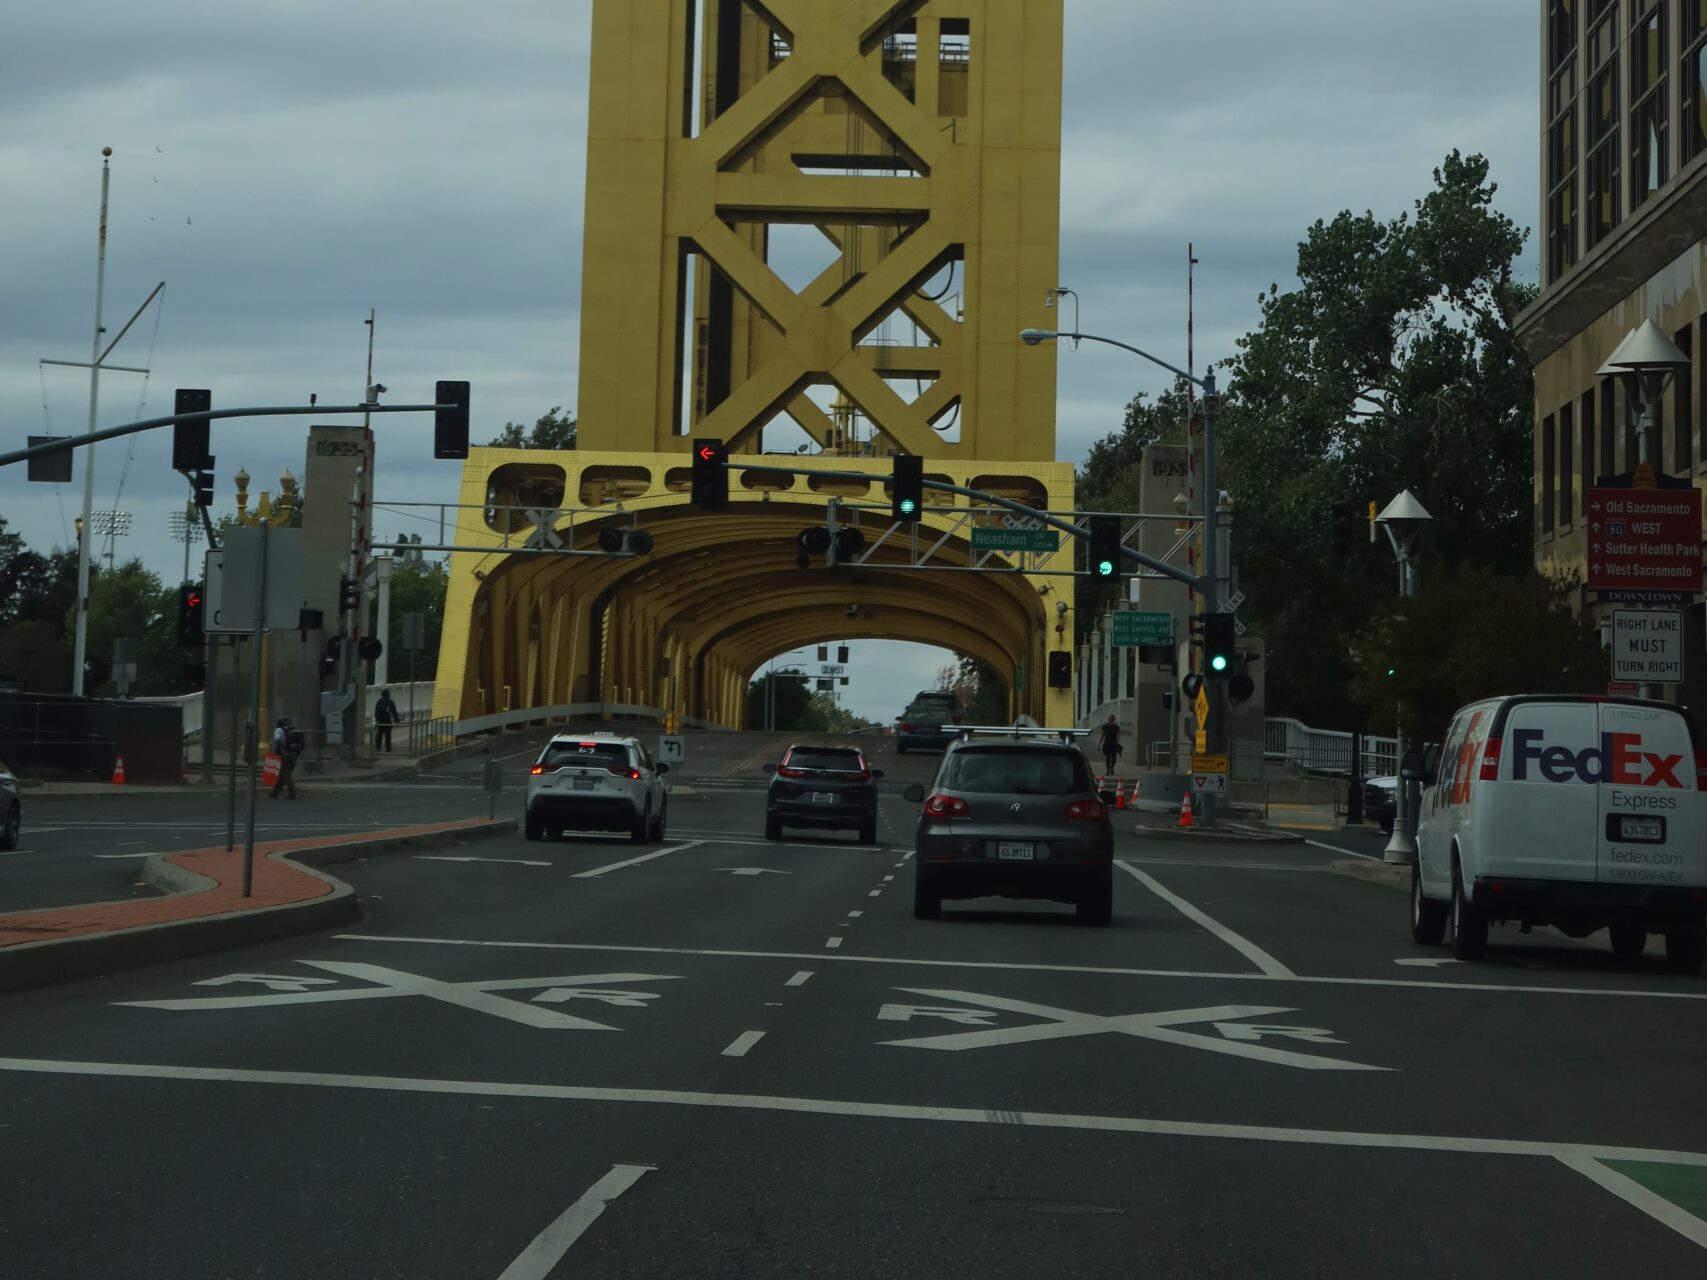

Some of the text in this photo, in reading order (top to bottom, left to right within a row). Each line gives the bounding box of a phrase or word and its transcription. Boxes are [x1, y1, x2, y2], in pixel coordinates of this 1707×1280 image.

[318, 441, 357, 456] 1935
[1154, 461, 1187, 477] 193
[1606, 501, 1691, 515] Old Sacramento
[1631, 522, 1662, 535] WEST
[975, 533, 1027, 545] Neasham
[1605, 542, 1700, 556] Sutter Health Park
[1606, 563, 1692, 577] West Sacramento
[1608, 592, 1681, 601] DOWNTOWN
[1617, 619, 1678, 631] RIGHT LANE
[1629, 639, 1667, 653] MUST
[1617, 660, 1679, 673] TURN RIGHT
[1513, 728, 1685, 789] FedEx
[1612, 790, 1677, 811] Express
[1611, 848, 1683, 865] fedex.com
